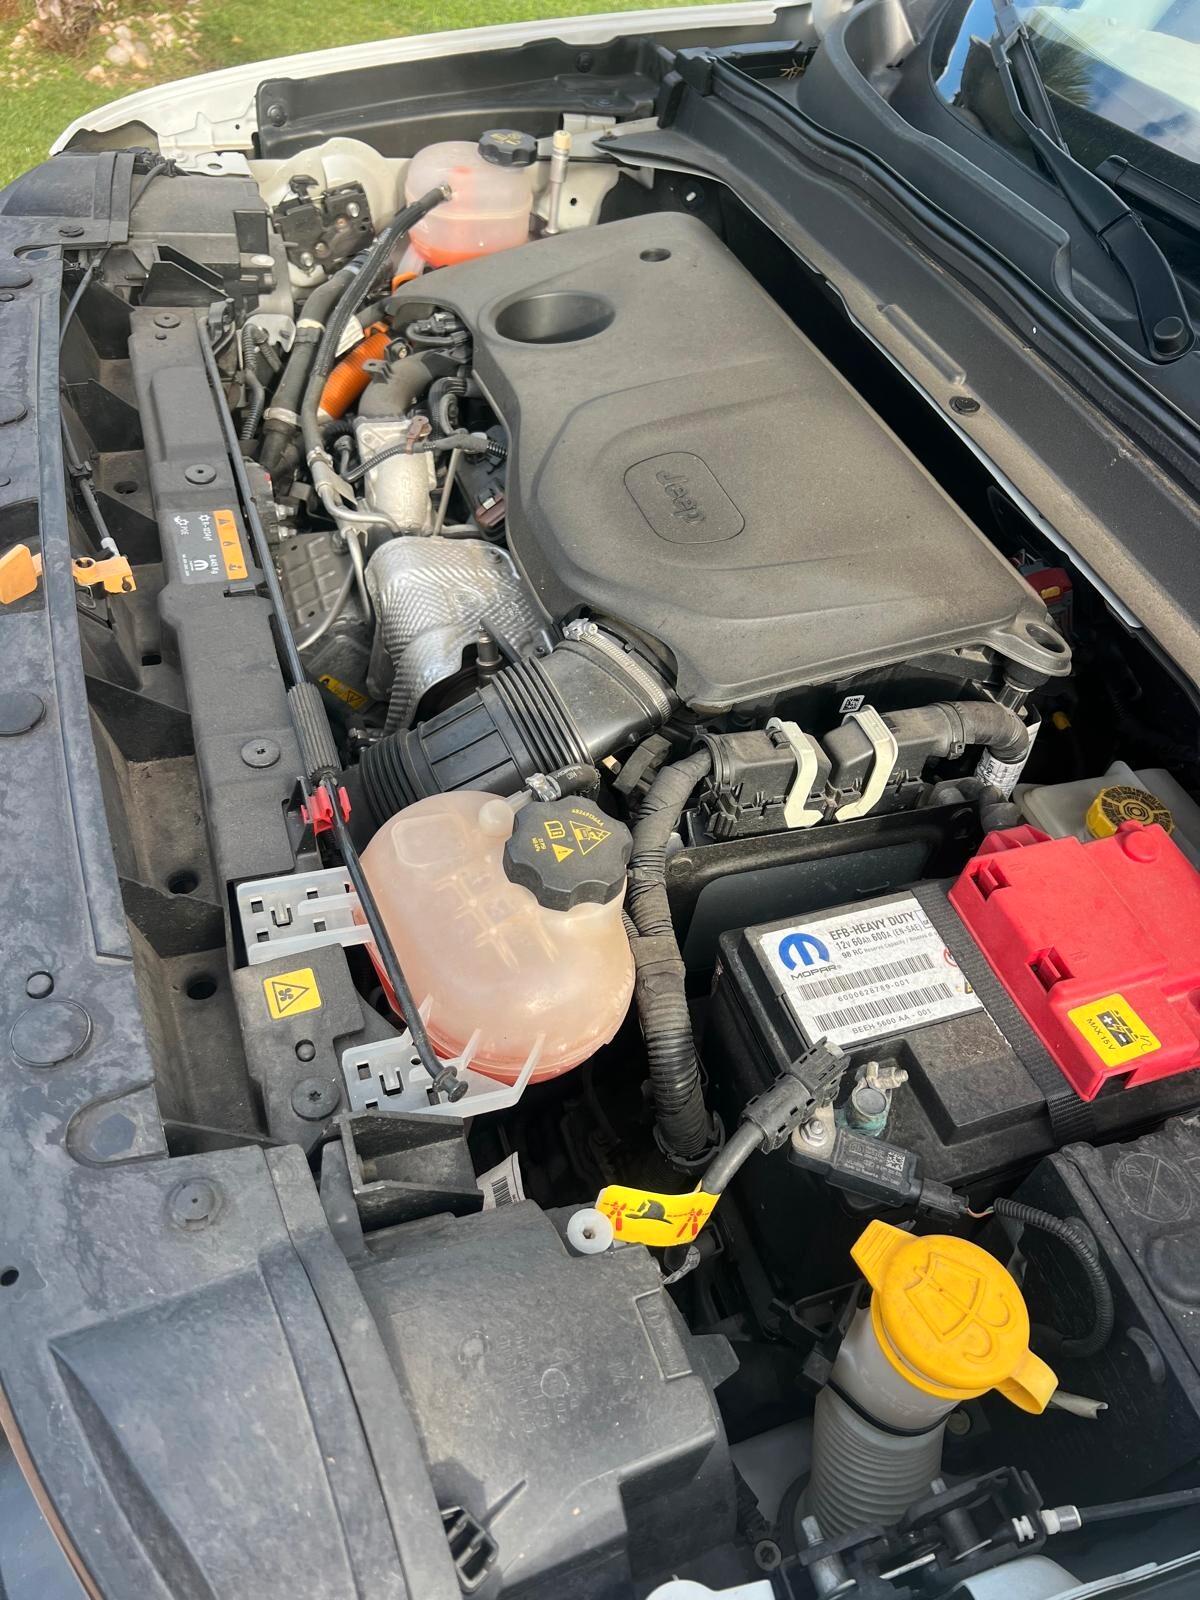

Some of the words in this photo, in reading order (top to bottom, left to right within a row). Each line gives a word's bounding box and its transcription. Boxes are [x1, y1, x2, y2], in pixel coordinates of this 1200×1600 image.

[656, 469, 705, 523] Jeep
[829, 919, 887, 941] EFB-HEAVY
[887, 911, 915, 926] DUTY
[852, 936, 872, 947] 60Ah
[871, 930, 891, 941] 600A
[894, 924, 922, 938] (EN-SAE)
[841, 950, 852, 959] 98
[853, 948, 864, 956] RC
[790, 964, 837, 980] MOPAR
[852, 1023, 875, 1034] BEEH
[917, 1008, 932, 1017] 001
[1086, 1018, 1102, 1035] MAX
